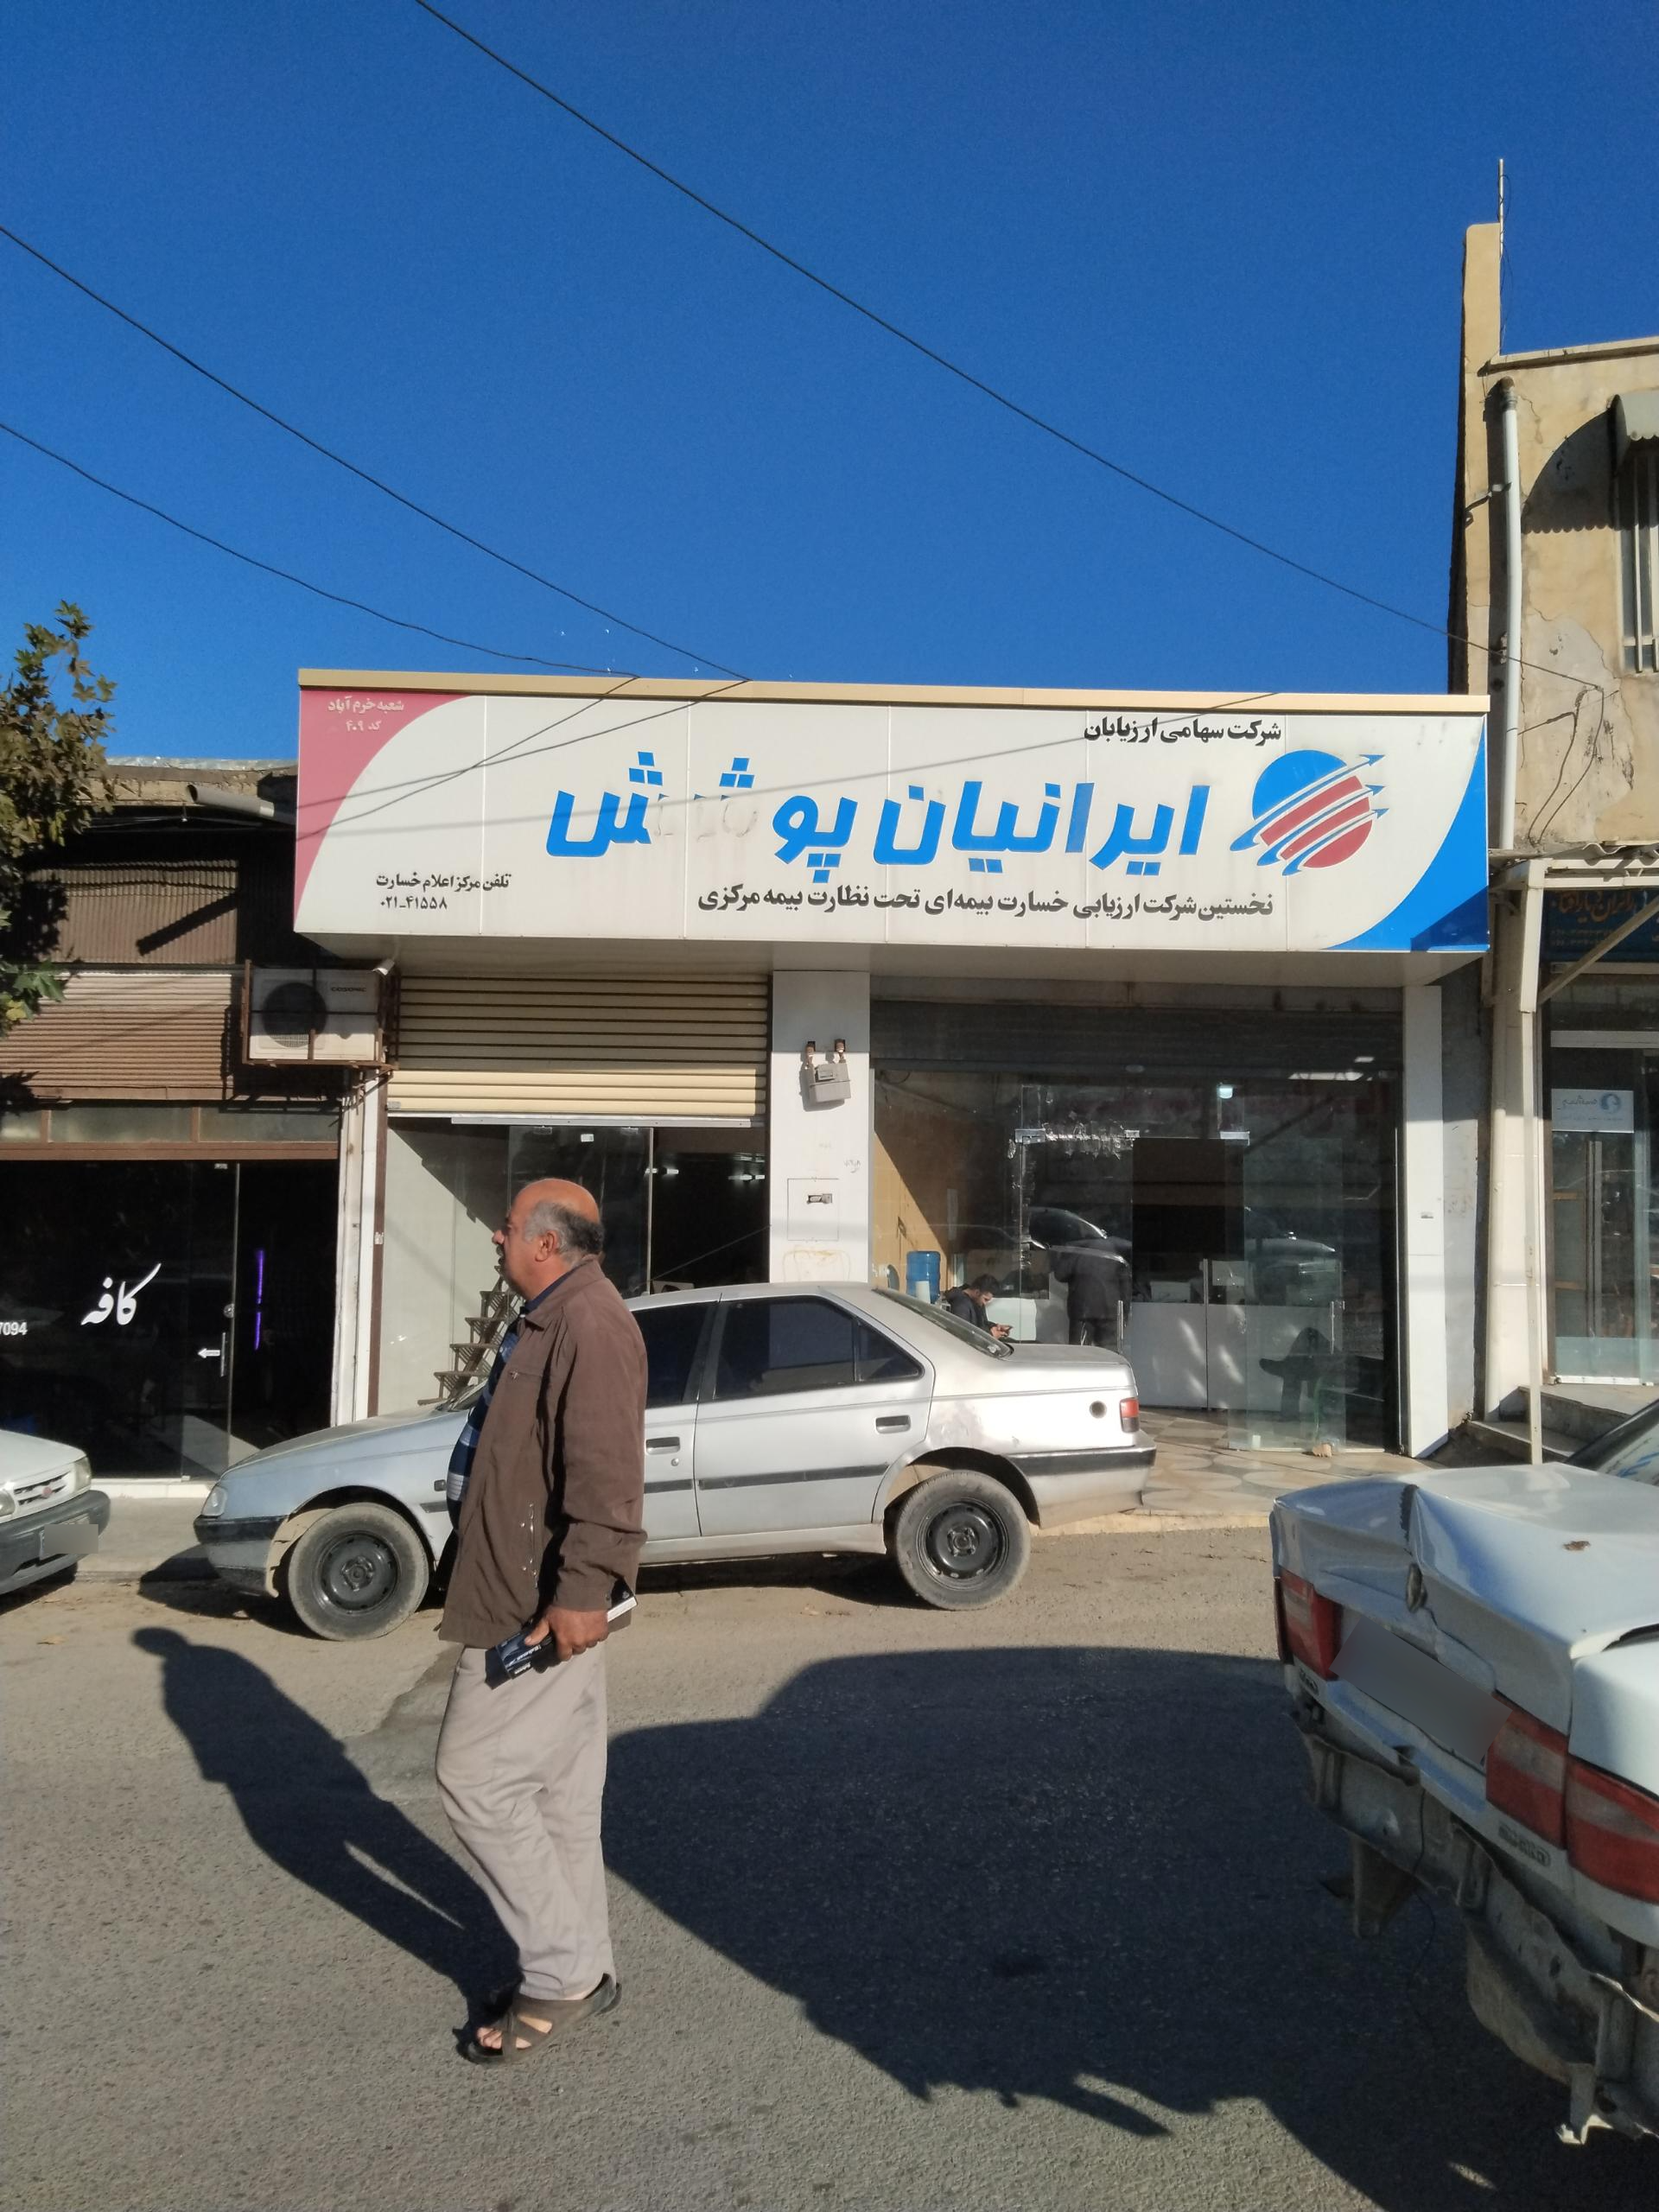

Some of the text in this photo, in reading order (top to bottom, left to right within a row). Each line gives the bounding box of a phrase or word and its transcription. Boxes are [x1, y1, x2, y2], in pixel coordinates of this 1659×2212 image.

[327, 695, 405, 715] شعبه خرم آباد
[346, 719, 382, 732] کد ۴۰۹
[1083, 716, 1282, 747] شرکت سهامی ارزیابان
[873, 780, 1211, 876] ایرانیان
[376, 871, 512, 893] تلفن مرکز اعلام خسارت
[698, 882, 761, 912] مرکزی
[763, 888, 804, 912] بیمه
[807, 884, 870, 914] نظارت
[874, 888, 921, 909] تحت
[997, 890, 1070, 918] خسارت
[1072, 893, 1141, 920] ارزیابی
[1143, 894, 1198, 922] شرکت
[1198, 893, 1274, 922] نخستین
[80, 1262, 162, 1326] کافه
